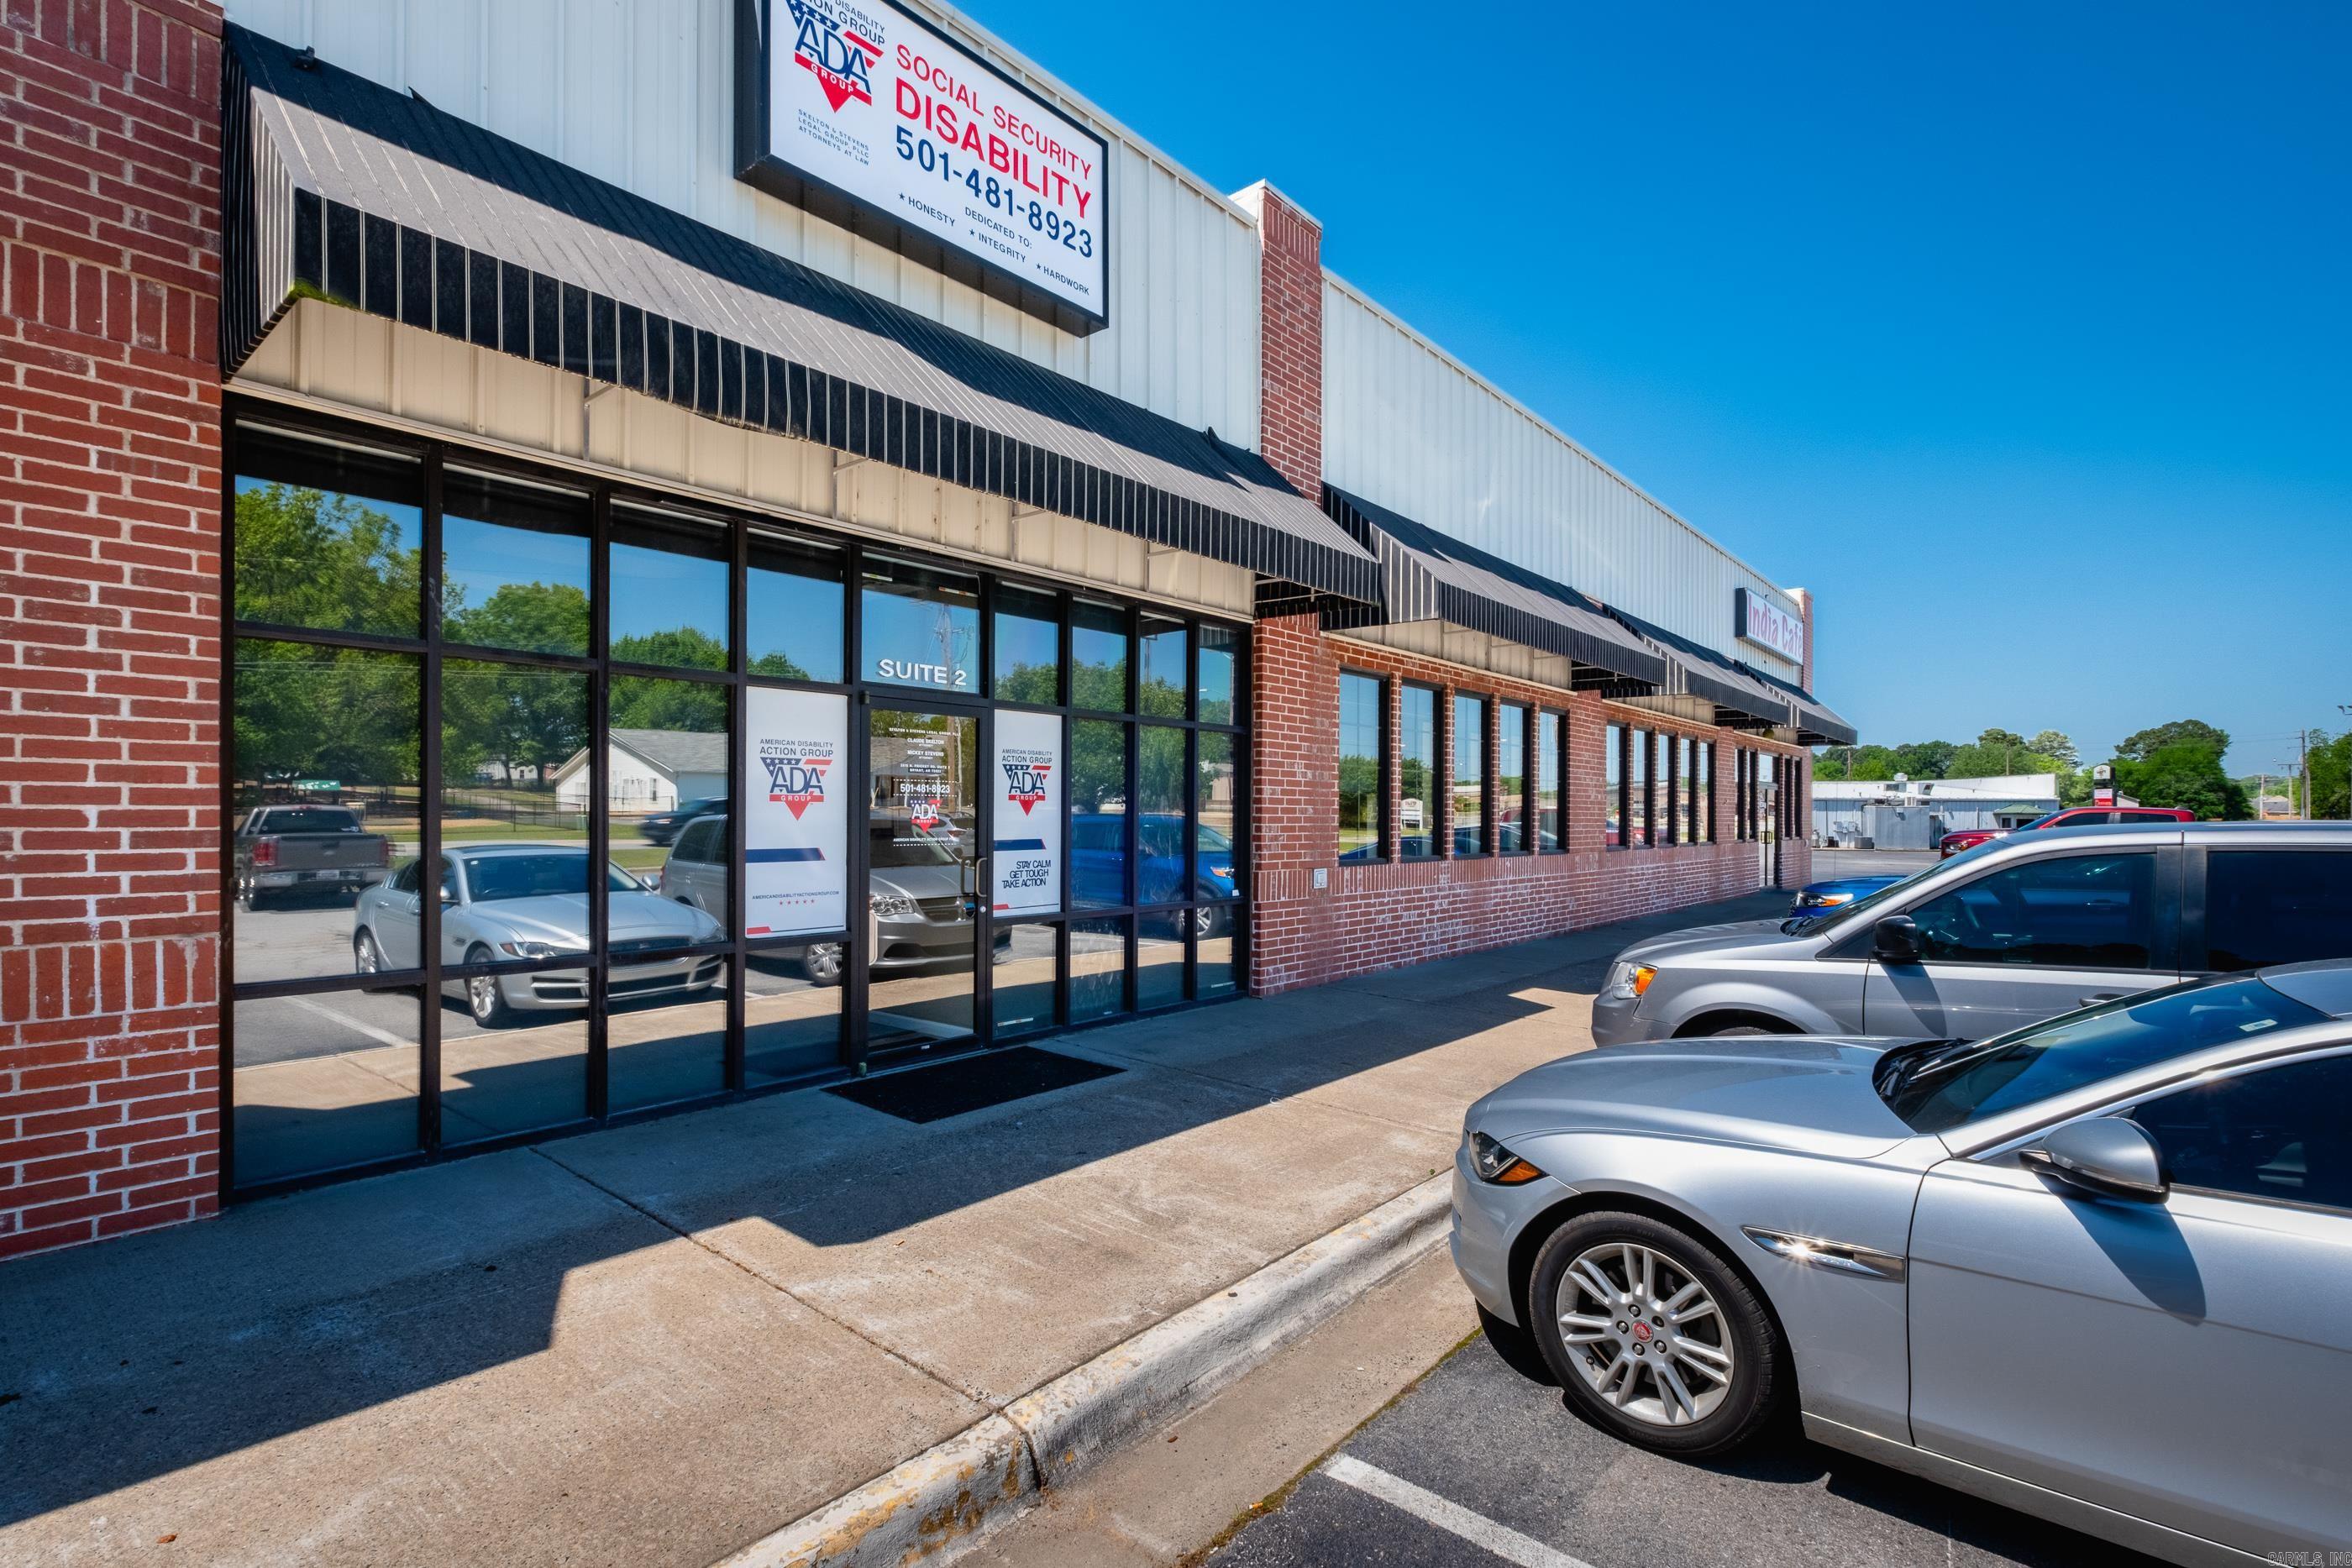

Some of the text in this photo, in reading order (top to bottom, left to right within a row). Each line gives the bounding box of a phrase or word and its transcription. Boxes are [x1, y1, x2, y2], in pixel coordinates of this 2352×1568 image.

[838, 11, 885, 45] GROUP
[795, 17, 872, 95] ADA
[811, 63, 854, 93] GROUP
[798, 108, 830, 129] SKELTON
[839, 130, 869, 151] STEVENS
[896, 44, 1092, 181] SOCIAL SECURITY
[798, 116, 822, 133] LEGAL
[853, 145, 869, 158] PLLC
[799, 125, 869, 165] ATTORNEYS AT LAW
[895, 76, 1092, 219] DISABILITY
[896, 124, 1093, 259] 501-481-8923
[965, 207, 1032, 249] DEDICATED TO:
[908, 196, 1089, 296] HONESTY INTEGRITY HARDWORK
[1748, 593, 1778, 647] India
[879, 658, 967, 686] SUITE 2
[759, 746, 833, 757] ACTION GROUP
[769, 766, 824, 794] ADA
[900, 783, 950, 794] 501-481-8923
[1008, 771, 1046, 794] ADA
[911, 804, 939, 820] ADA
[1009, 868, 1049, 879] GET TOUGH
[1016, 859, 1052, 869] STAY CALM
[1001, 878, 1047, 889] TAKE ACTION
